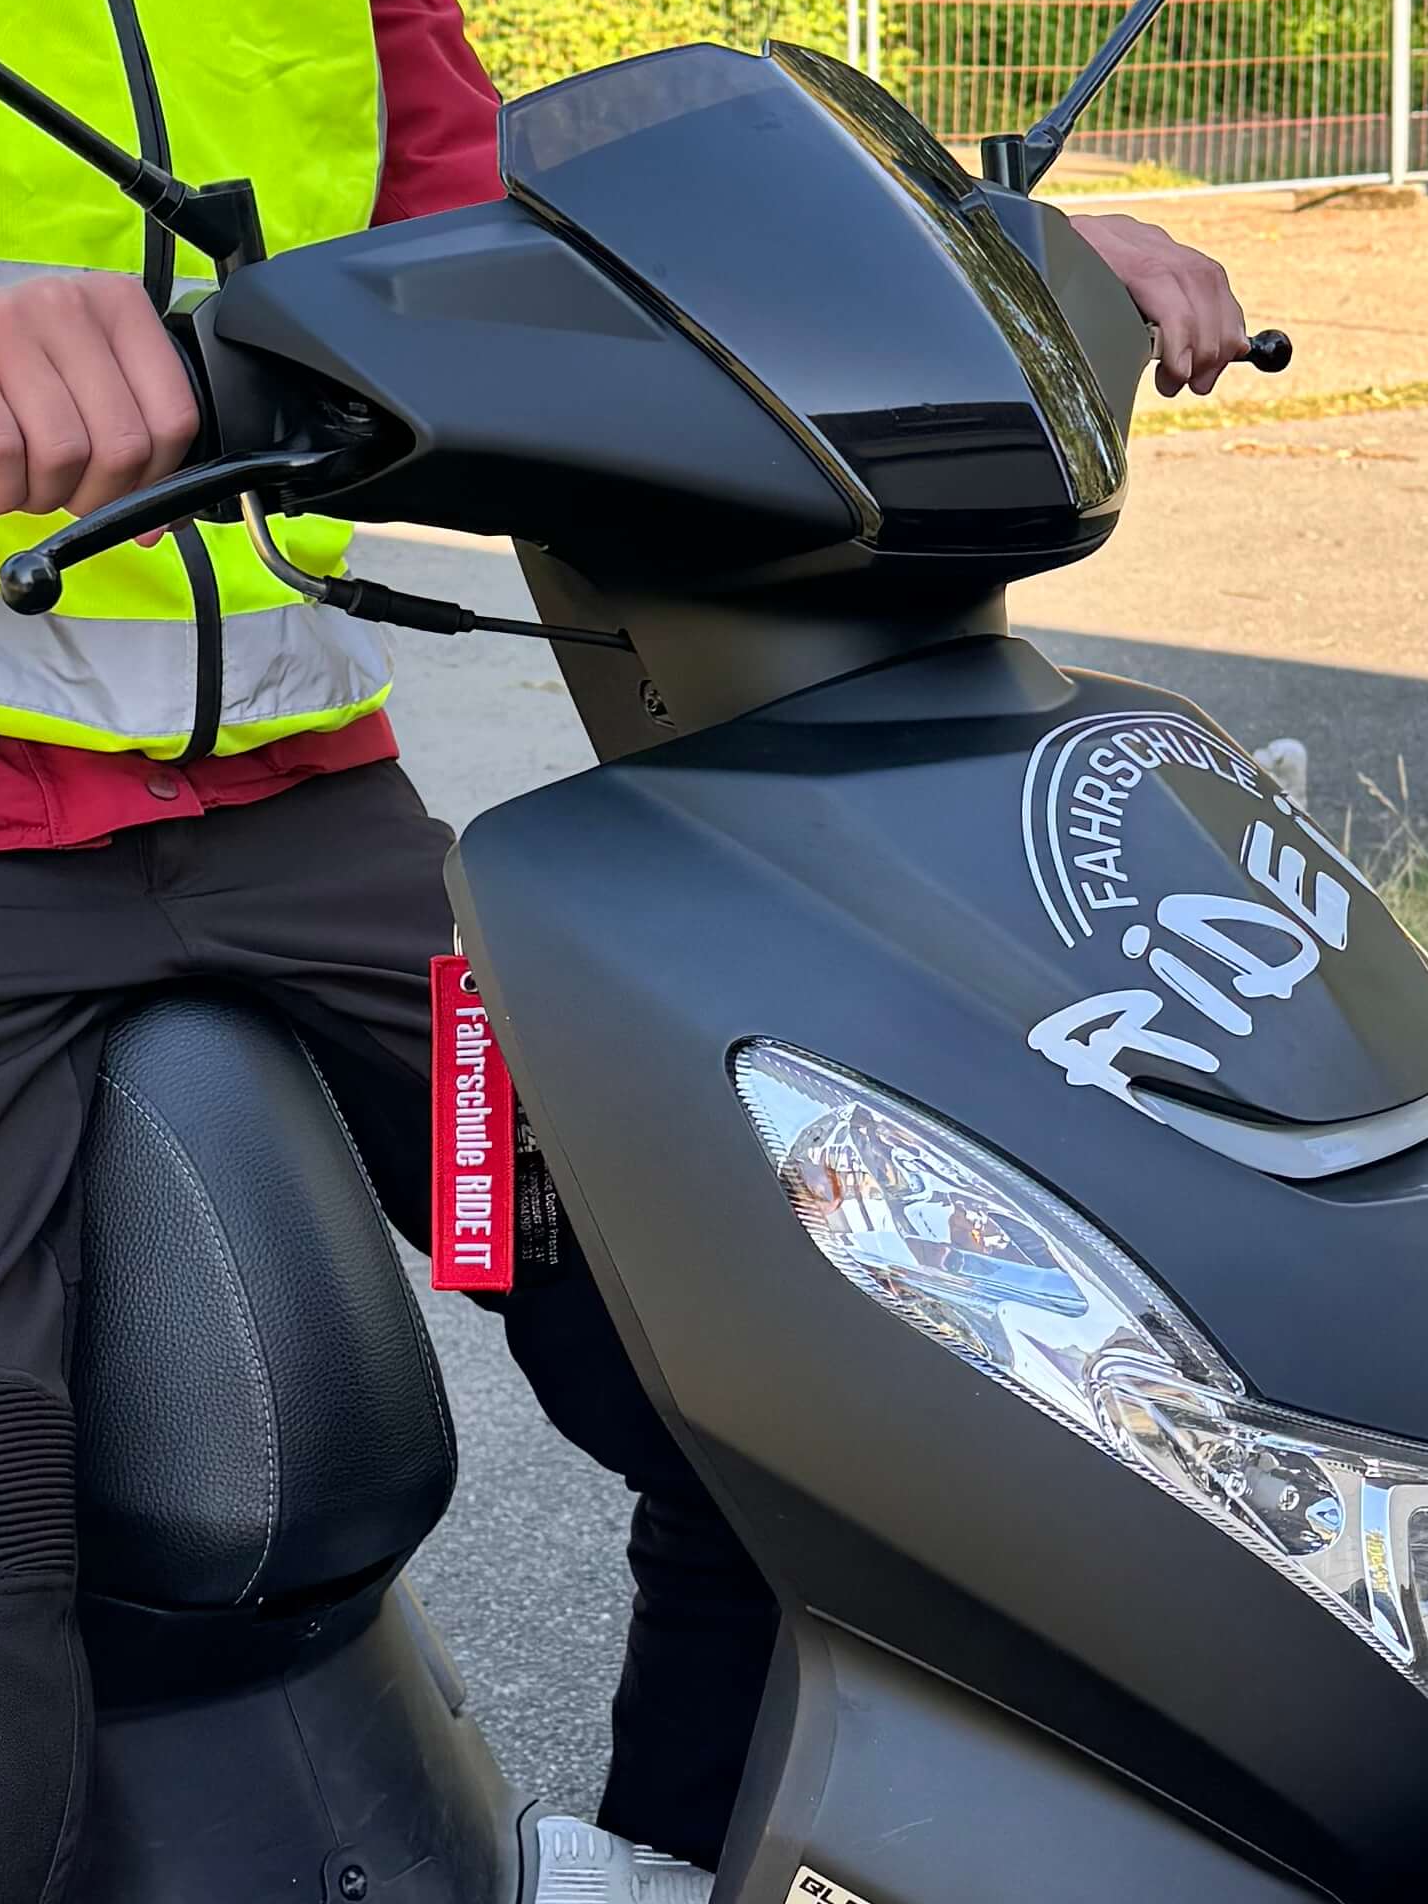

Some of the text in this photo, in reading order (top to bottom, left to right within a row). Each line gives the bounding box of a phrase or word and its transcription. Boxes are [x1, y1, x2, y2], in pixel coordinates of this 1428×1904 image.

[1068, 726, 1264, 910] FAHRSCHULE
[453, 1007, 493, 1271] Fahrschule RIDE IT
